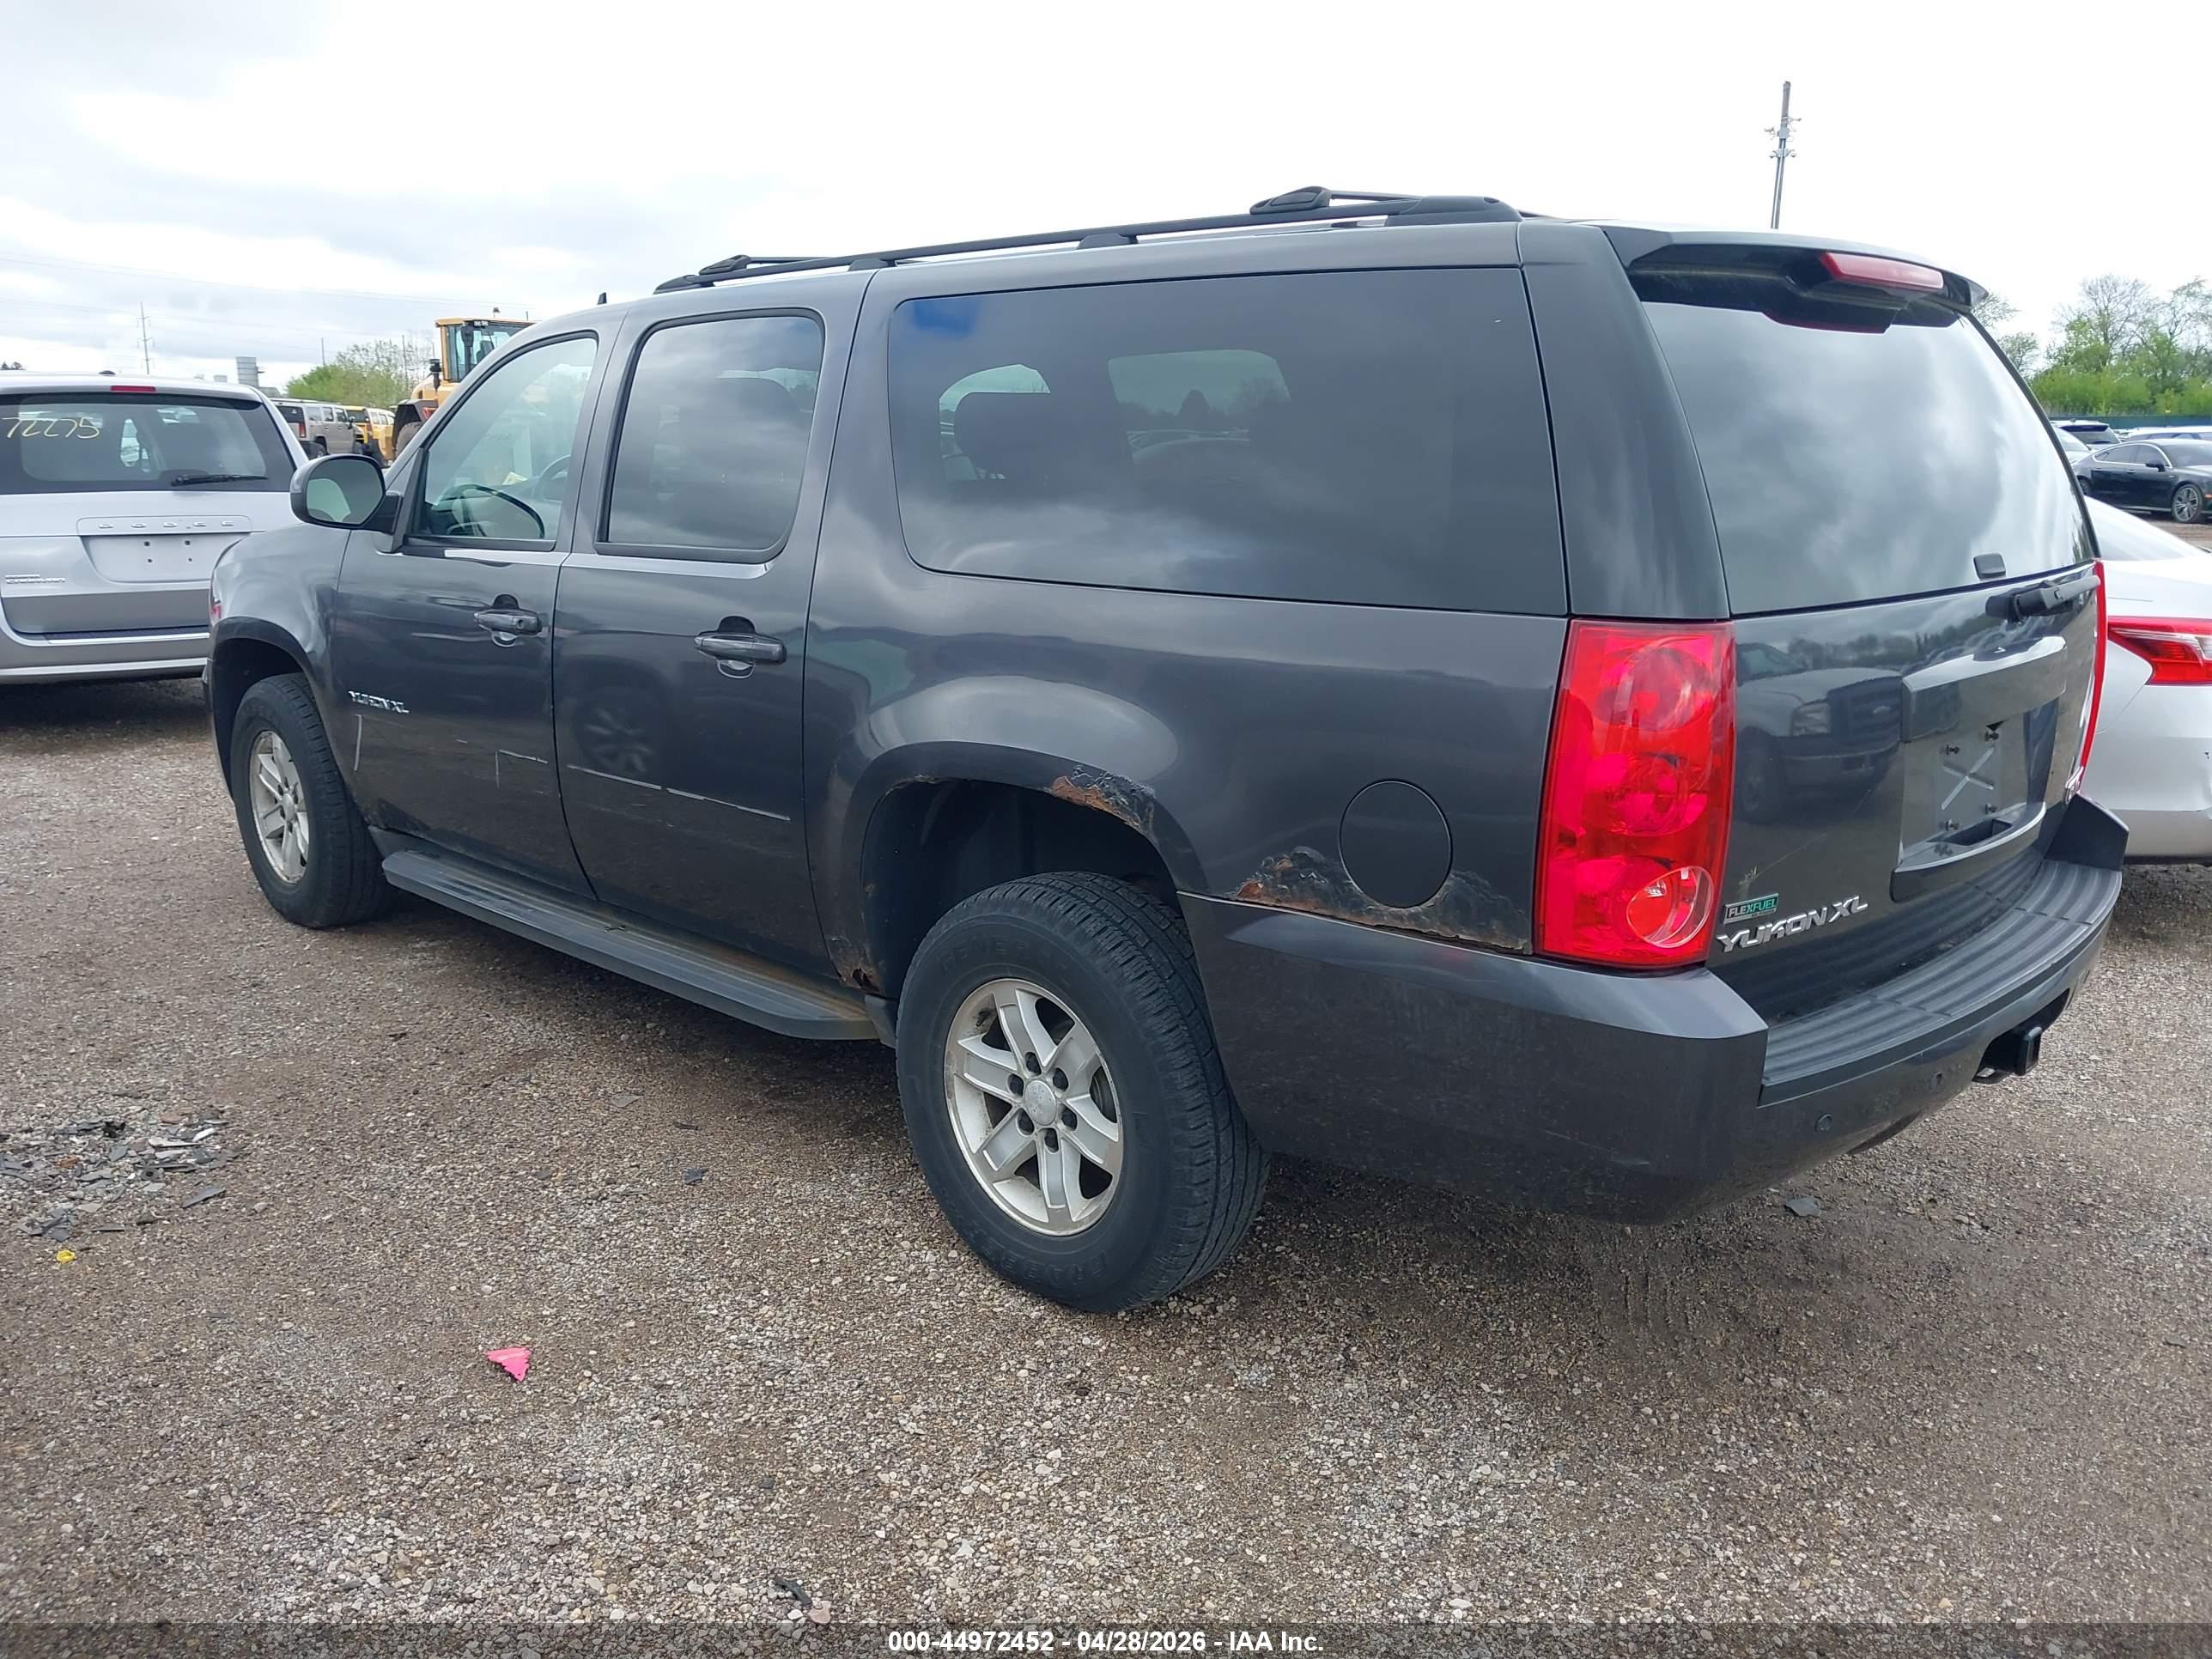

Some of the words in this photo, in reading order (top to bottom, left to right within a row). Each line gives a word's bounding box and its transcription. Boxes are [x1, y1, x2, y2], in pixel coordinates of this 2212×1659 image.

[98, 520, 235, 529] DODGE
[389, 701, 410, 714] XL
[1729, 899, 1777, 918] FLEXFUEL
[1717, 907, 1827, 953] YUKON
[1828, 895, 1869, 922] XL
